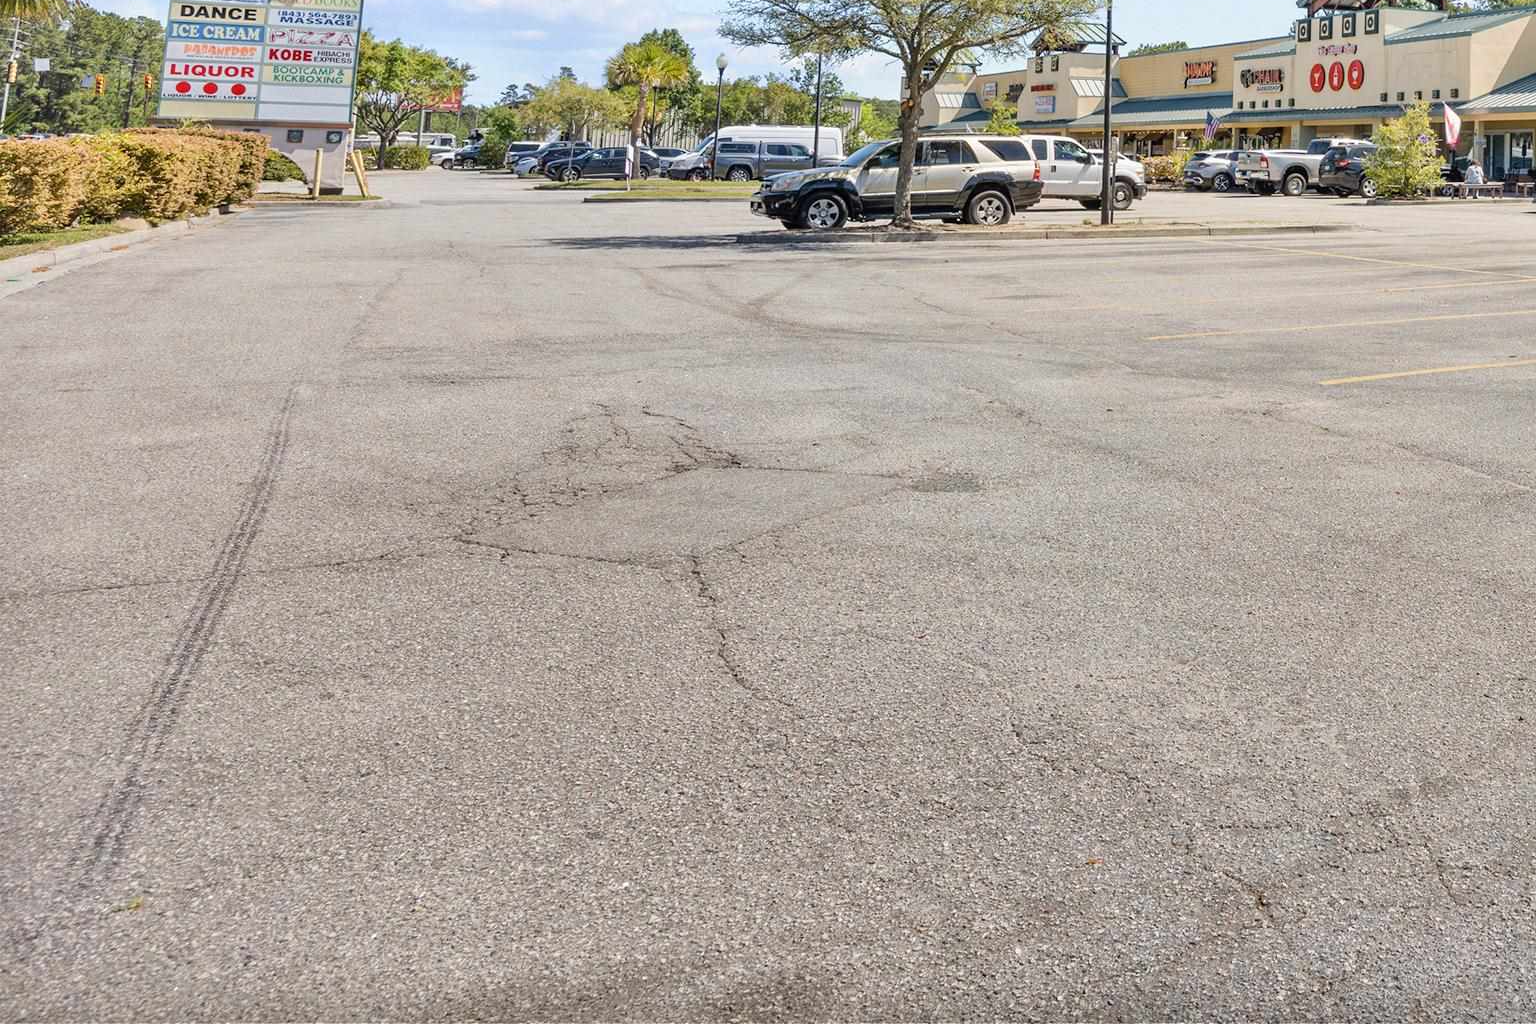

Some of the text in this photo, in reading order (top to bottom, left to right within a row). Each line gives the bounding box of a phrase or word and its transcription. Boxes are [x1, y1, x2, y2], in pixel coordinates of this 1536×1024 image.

[180, 5, 257, 21] DANCE
[280, 17, 354, 27] MASSAGE
[171, 23, 260, 41] ICE CREAM
[268, 29, 355, 47] PIZZA
[268, 48, 313, 61] KOBE
[316, 50, 351, 59] HIBACHI
[313, 57, 353, 65] EXPRESS
[169, 63, 255, 79] LIQUOR
[273, 64, 335, 76] BOOTCAMP
[273, 74, 344, 85] KICKBOXING
